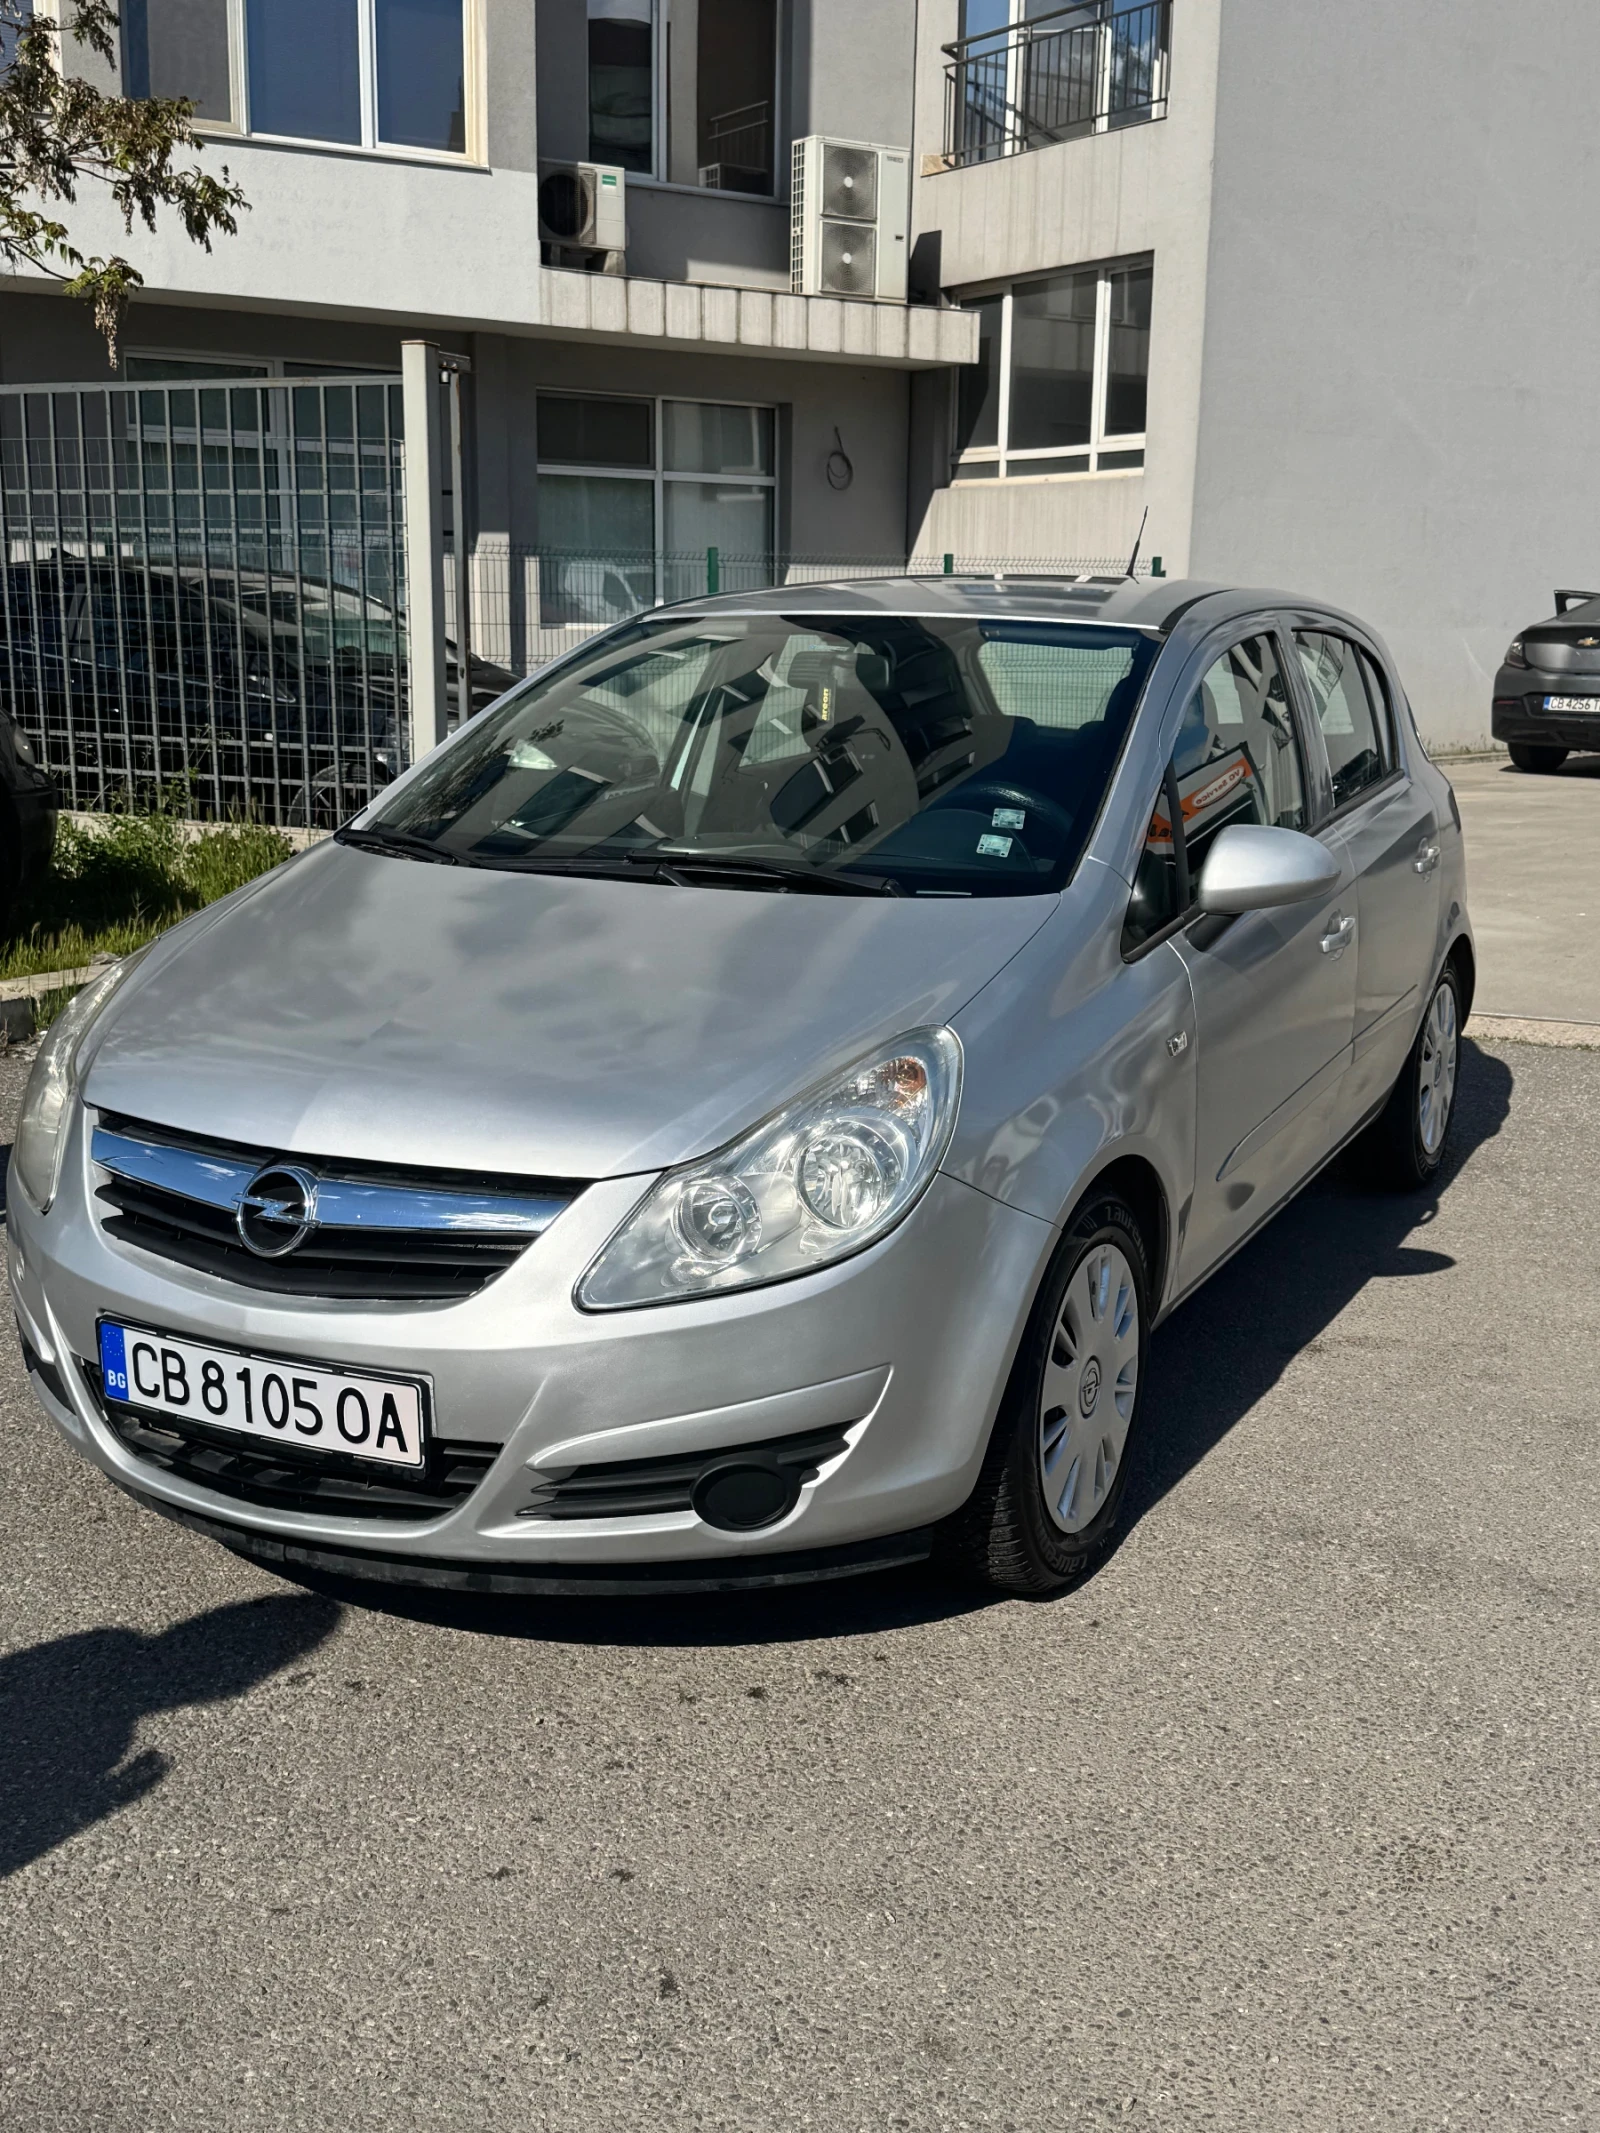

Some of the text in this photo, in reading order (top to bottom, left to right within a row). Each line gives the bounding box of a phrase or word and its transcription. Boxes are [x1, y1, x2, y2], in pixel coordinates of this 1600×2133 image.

[1551, 697, 1564, 709] CB
[1566, 698, 1591, 710] 4256
[1594, 699, 1600, 710] T
[107, 1370, 126, 1389] BG
[131, 1342, 409, 1453] CB 8105 OA
